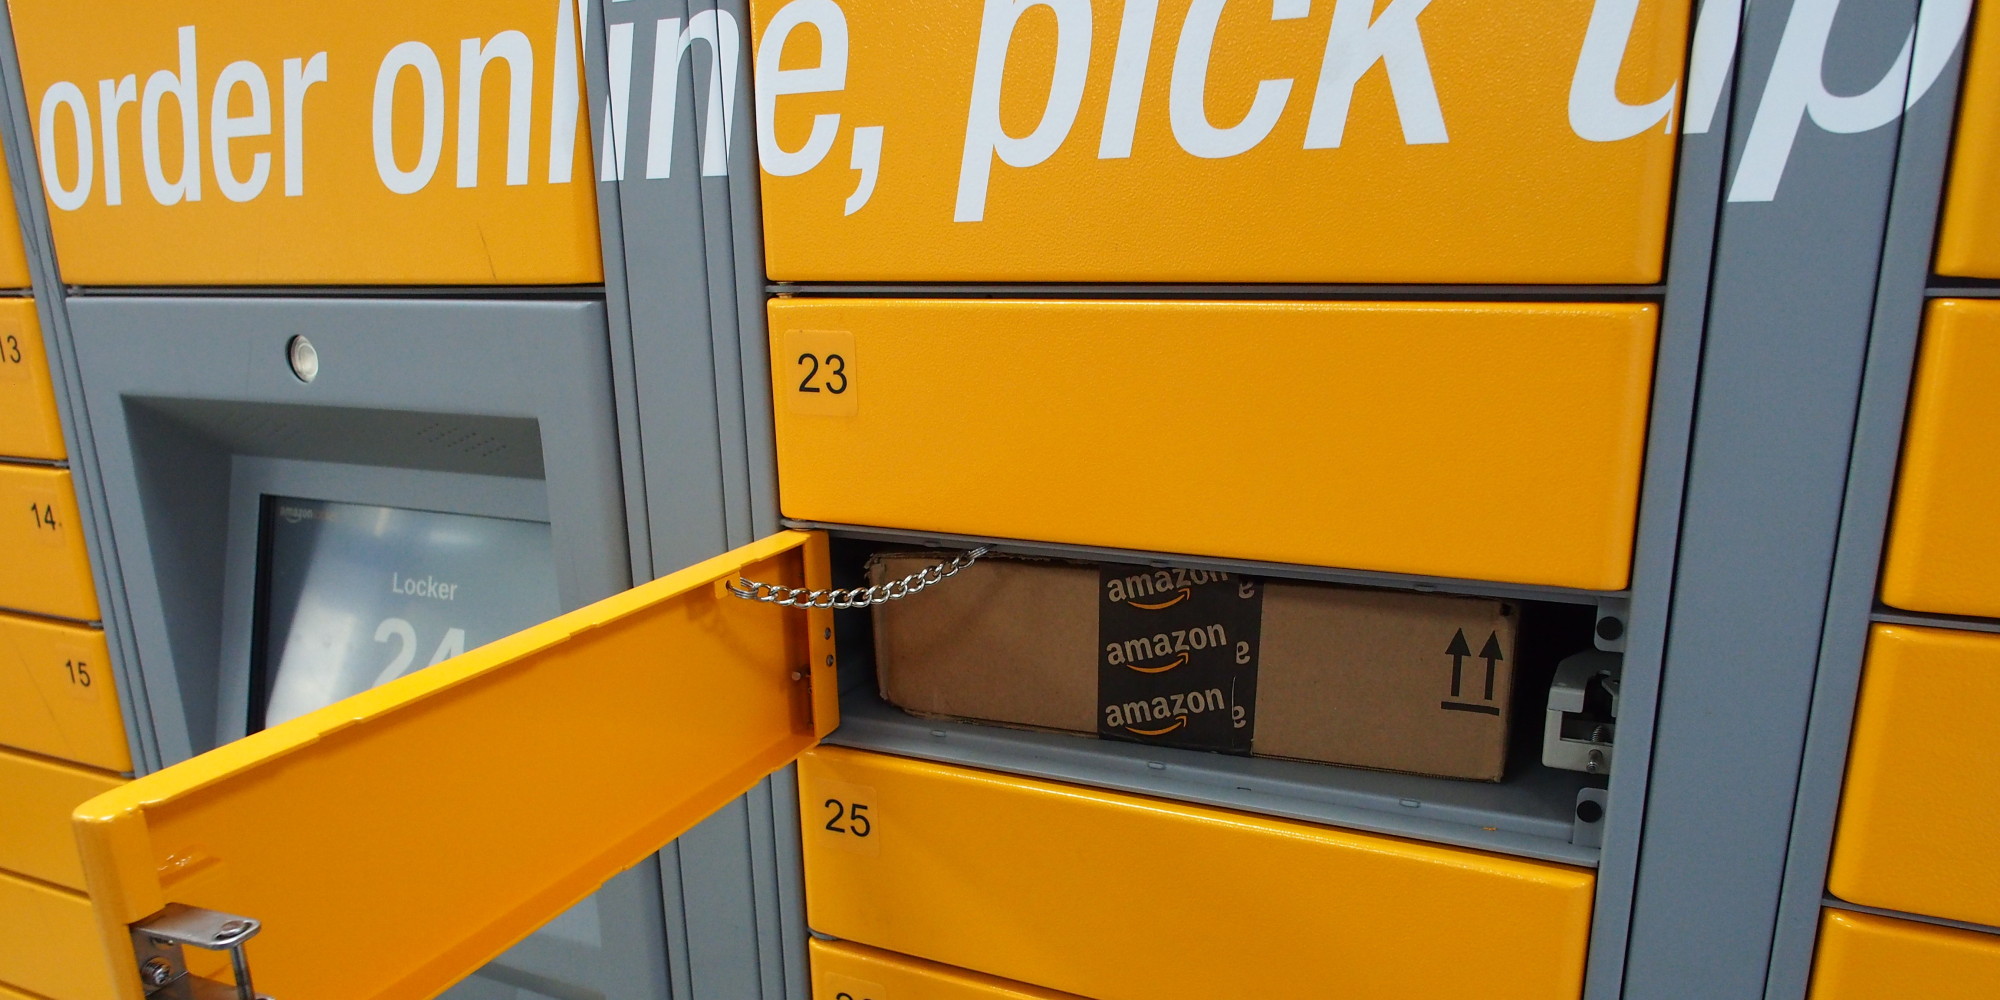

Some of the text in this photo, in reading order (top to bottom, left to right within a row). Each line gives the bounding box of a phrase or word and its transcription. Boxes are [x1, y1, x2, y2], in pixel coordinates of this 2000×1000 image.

[39, 0, 1972, 222] order online, pick up
[798, 353, 847, 394] 23
[392, 572, 458, 600] Locker
[1106, 623, 1227, 665] amazon
[66, 659, 91, 687] 15
[1105, 688, 1224, 728] amazon
[824, 799, 871, 838] 25
